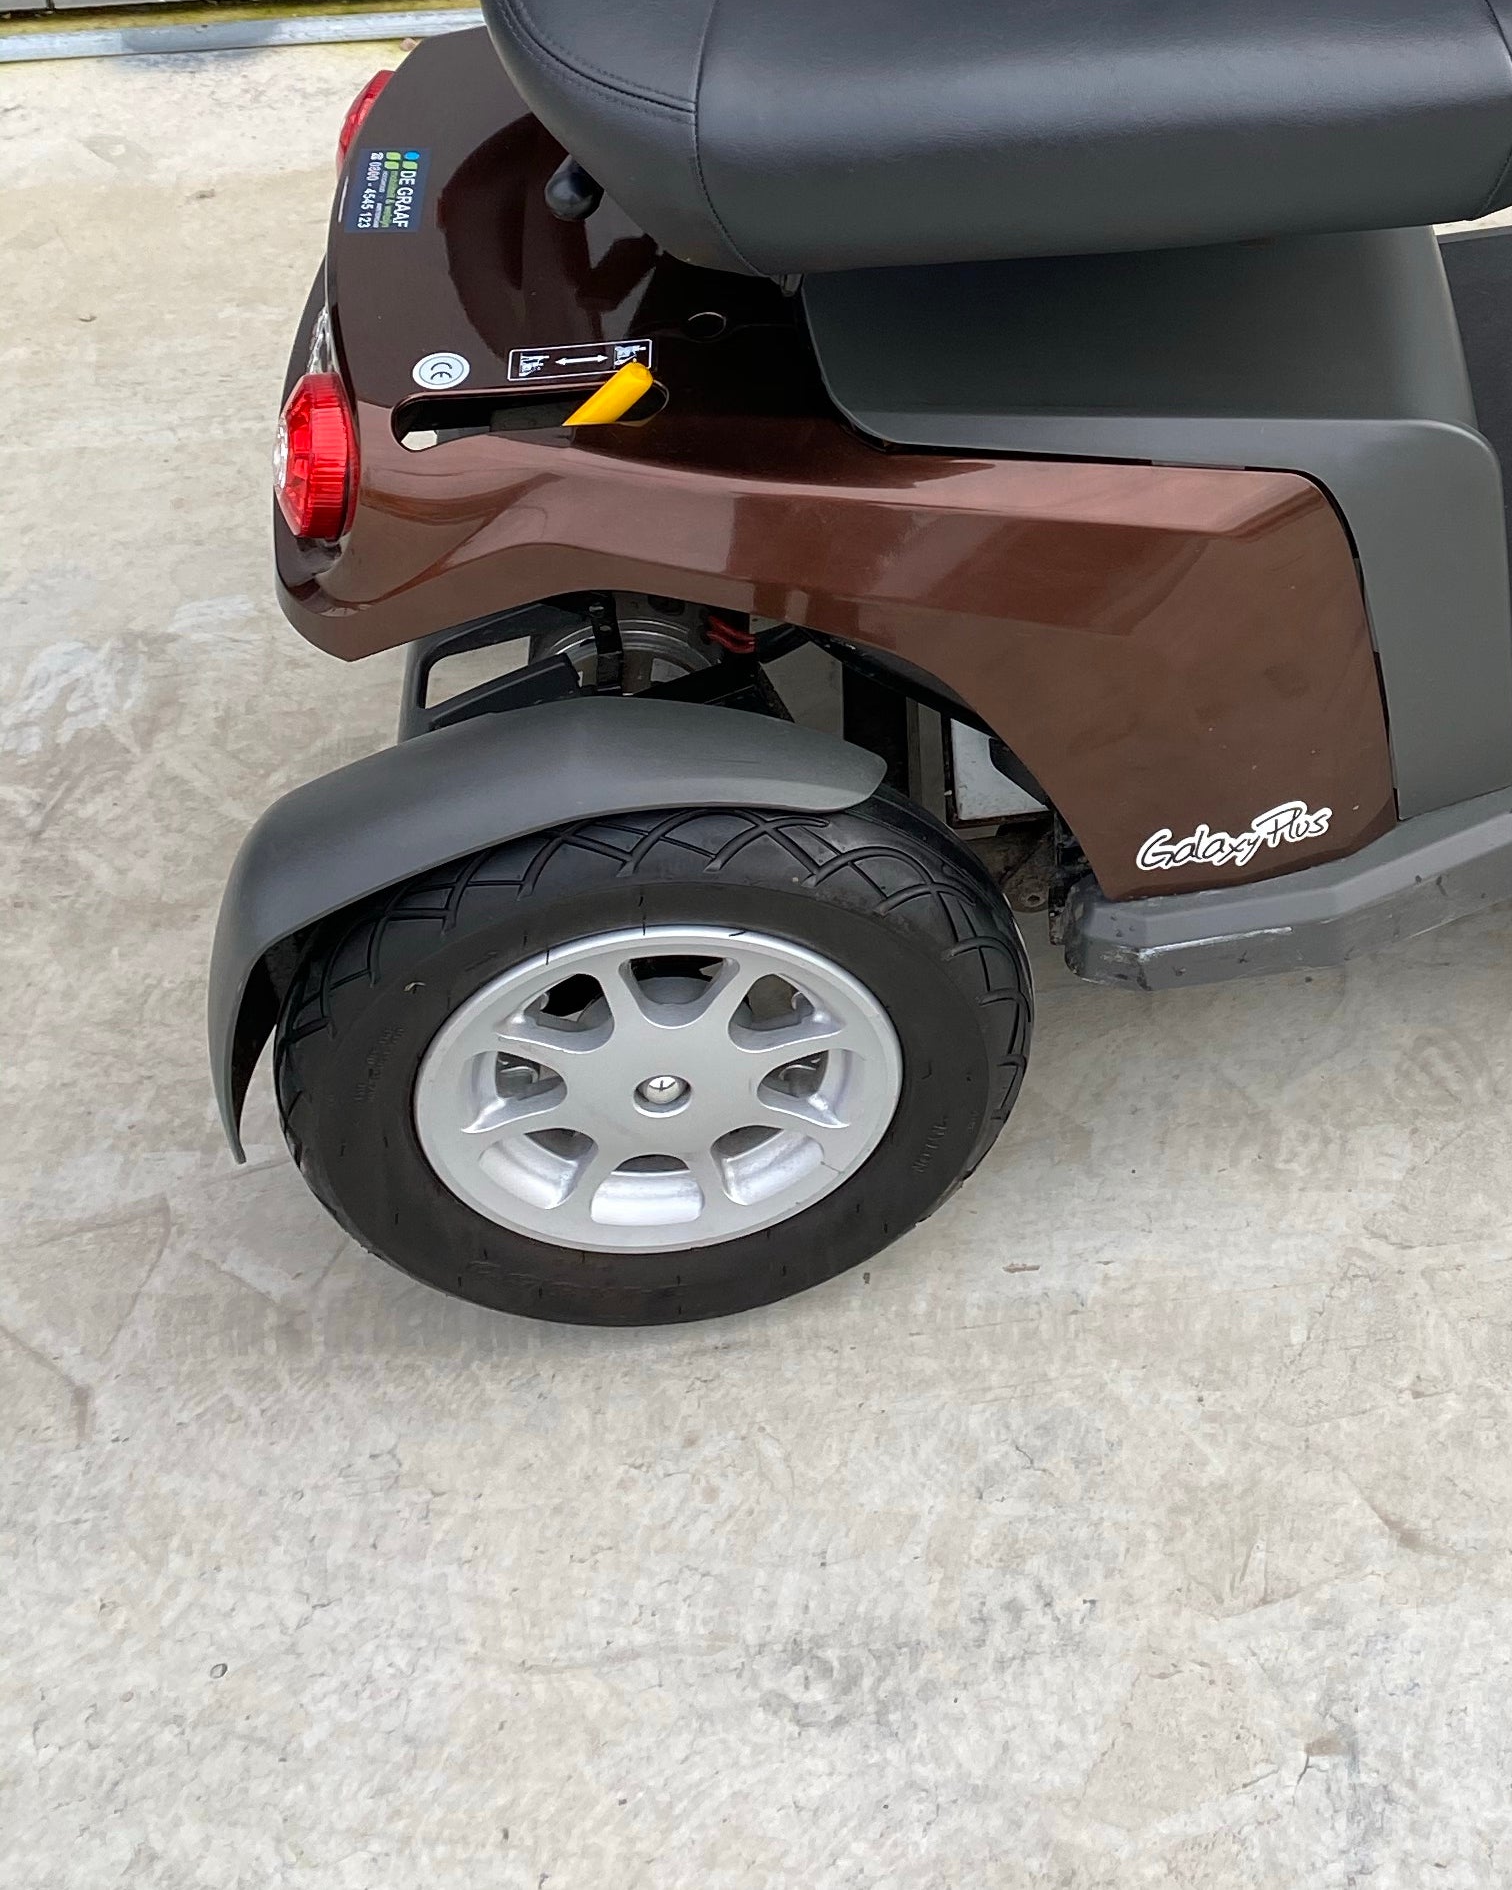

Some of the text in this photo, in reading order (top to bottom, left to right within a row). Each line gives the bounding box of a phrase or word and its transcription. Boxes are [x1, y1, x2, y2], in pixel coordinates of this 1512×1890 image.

[398, 170, 417, 185] DE
[360, 188, 377, 210] 4545
[392, 187, 414, 228] GRAAF
[357, 212, 373, 228] 123
